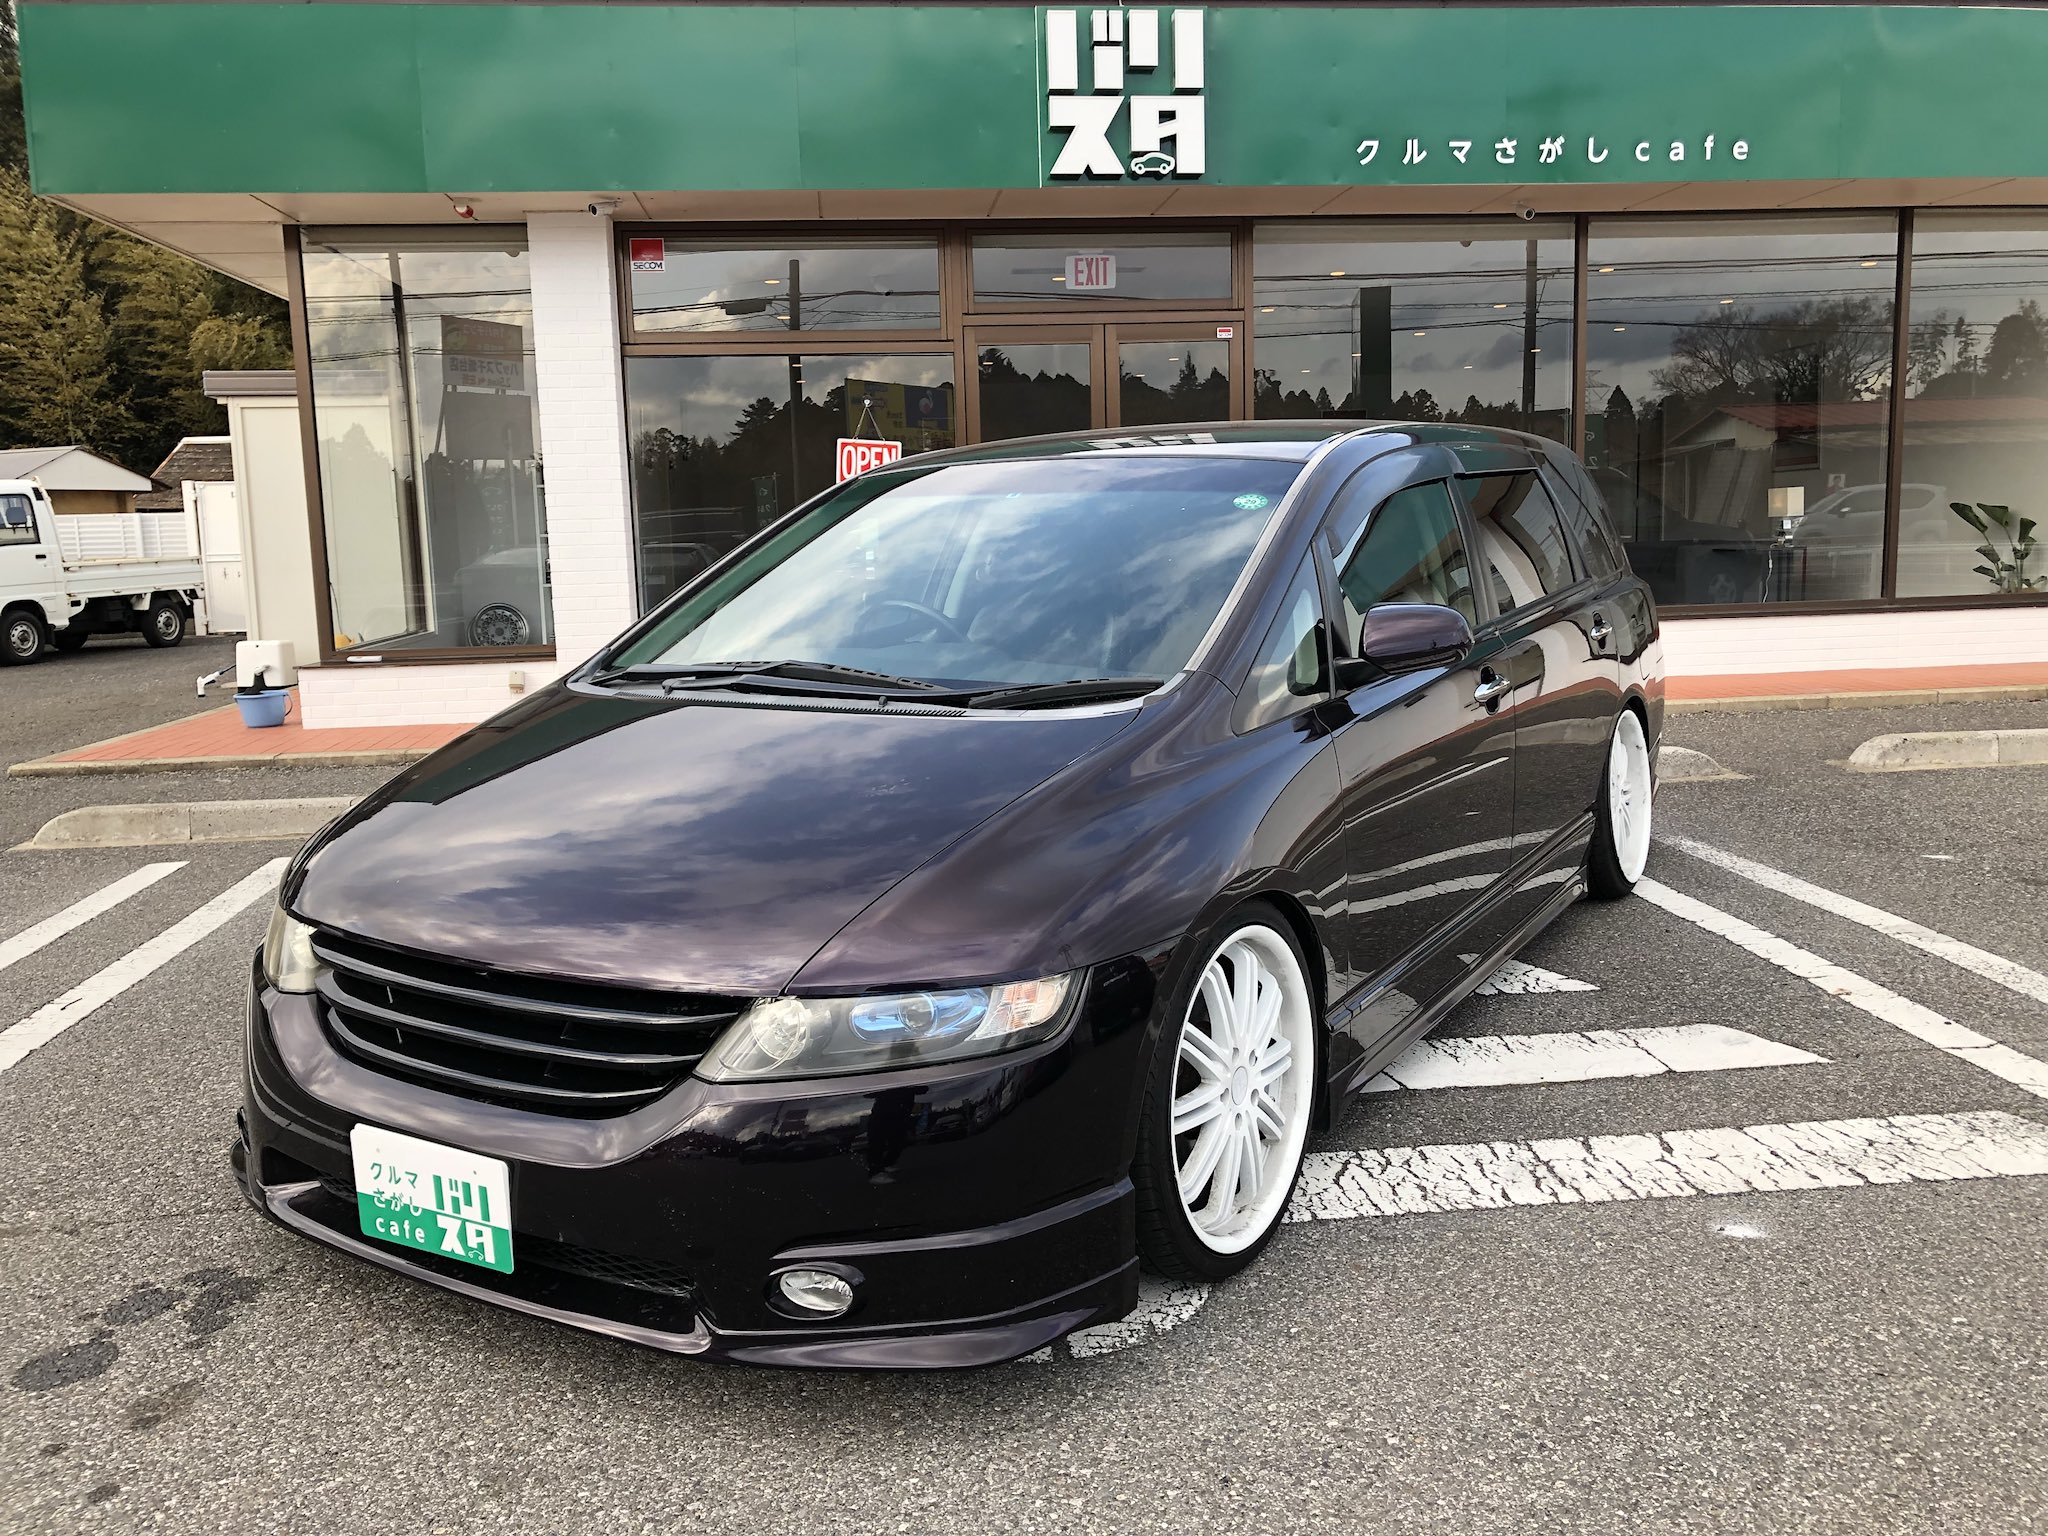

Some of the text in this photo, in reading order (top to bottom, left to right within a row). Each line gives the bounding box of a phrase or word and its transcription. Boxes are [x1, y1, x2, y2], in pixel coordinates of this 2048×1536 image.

[1356, 134, 1749, 166] クルマさがし cafe
[633, 261, 663, 270] SECOM
[1074, 257, 1110, 286] EXIT
[842, 445, 897, 479] OPEN
[370, 1162, 418, 1189] クルマ
[372, 1188, 422, 1217] さがし
[375, 1217, 426, 1244] cafe
